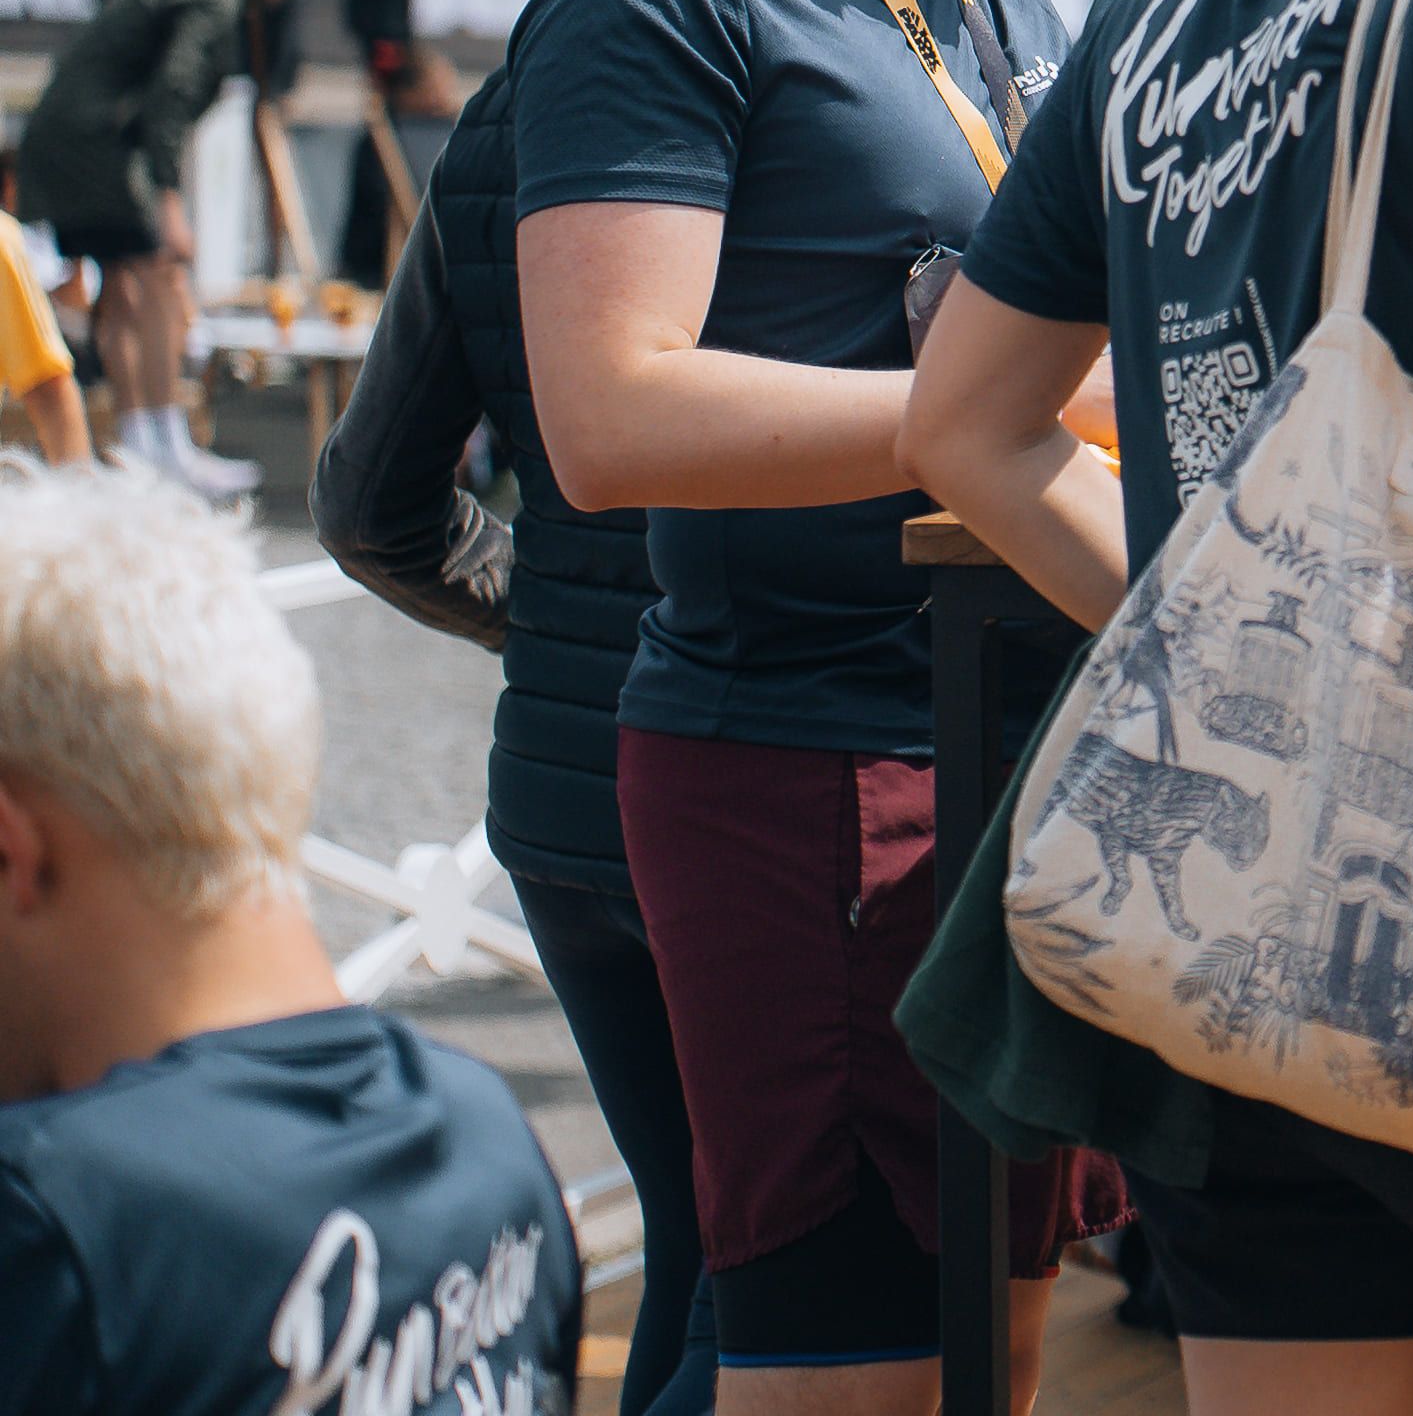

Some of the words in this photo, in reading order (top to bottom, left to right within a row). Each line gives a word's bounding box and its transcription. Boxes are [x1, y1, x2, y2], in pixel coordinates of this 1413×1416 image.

[1141, 69, 1322, 257] Togetr
[1158, 302, 1189, 322] ON
[1158, 314, 1230, 344] RECRUTE
